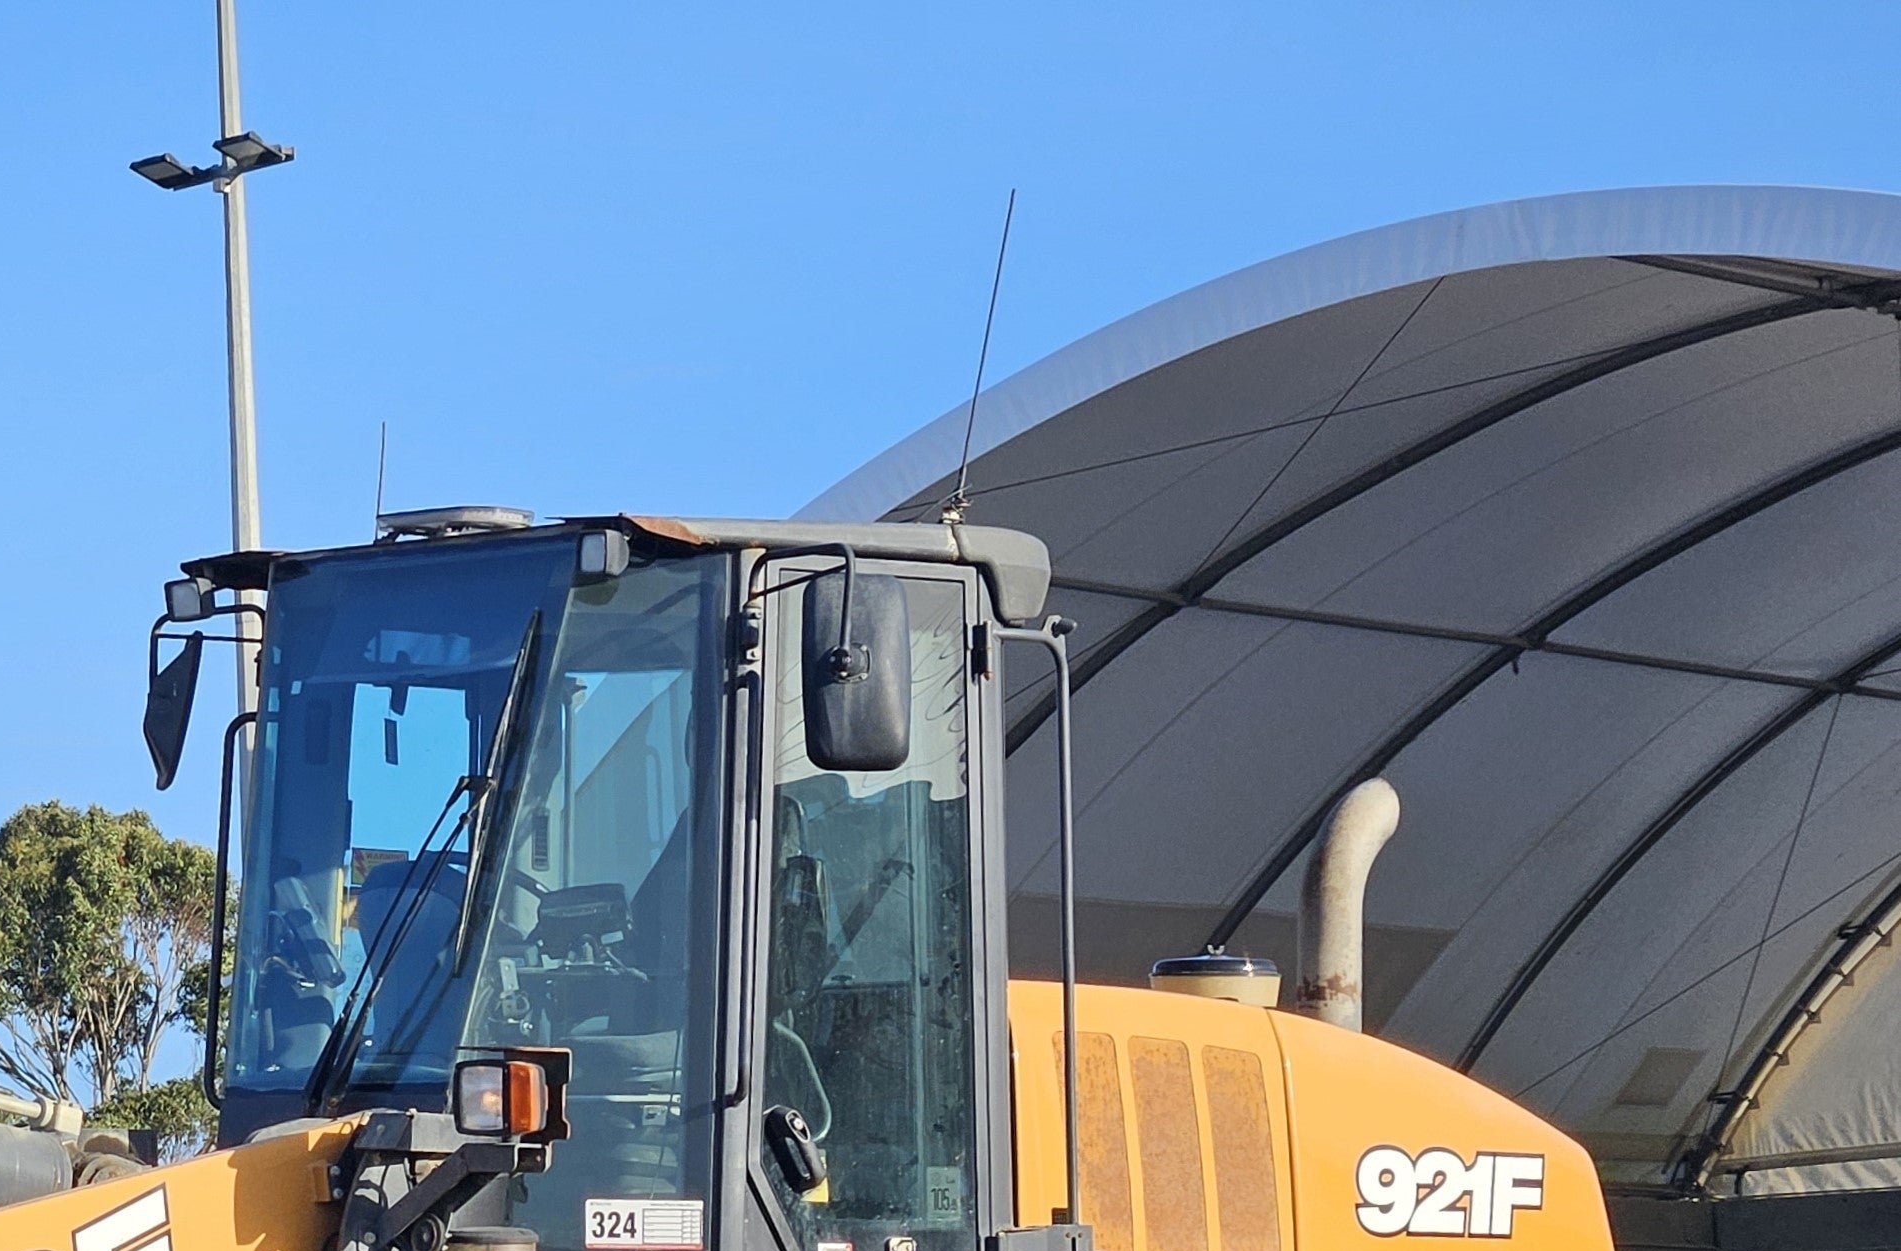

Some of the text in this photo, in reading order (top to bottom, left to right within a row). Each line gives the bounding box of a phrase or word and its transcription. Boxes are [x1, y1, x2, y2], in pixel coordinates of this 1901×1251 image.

[930, 1187, 950, 1211] 105
[1355, 1144, 1545, 1239] 921F
[591, 1211, 638, 1239] 324
